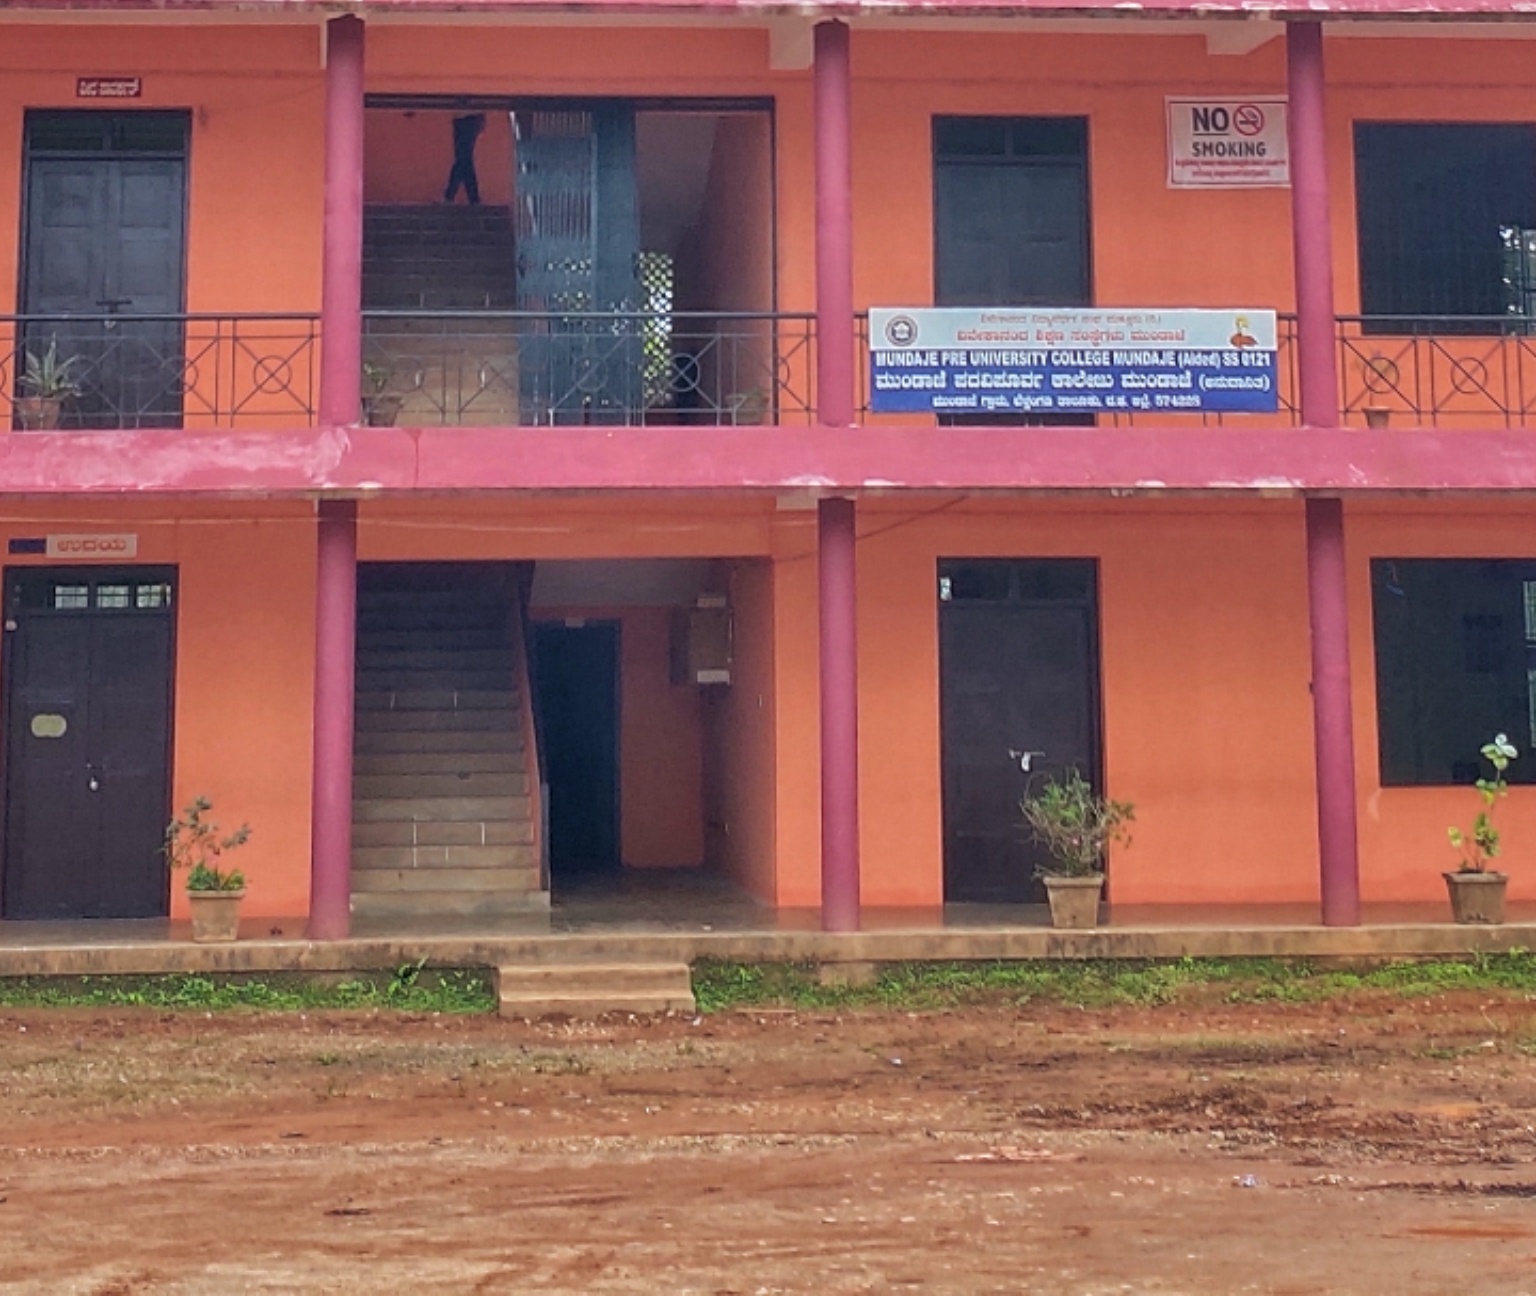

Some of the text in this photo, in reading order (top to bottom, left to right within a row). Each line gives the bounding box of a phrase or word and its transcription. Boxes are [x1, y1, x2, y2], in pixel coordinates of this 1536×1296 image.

[1192, 107, 1229, 132] NO
[1192, 141, 1266, 157] SMOKING
[876, 351, 1270, 369] MUNDAJE PRE UNIVERSITY COLLEGE MUNDAJE (Aided) SS 0121
[876, 370, 947, 389] ಮುಂಡಾಜೆ
[953, 371, 1044, 389] ಪದವಿಪೂರ್ವ
[1051, 370, 1114, 389] ಕಾಲೇಜು
[1120, 370, 1192, 388] ಮುಂಡಾಜೆ
[933, 393, 977, 407] ಮುಂಡಾಜೆ
[57, 538, 127, 552] ಉದಯ
